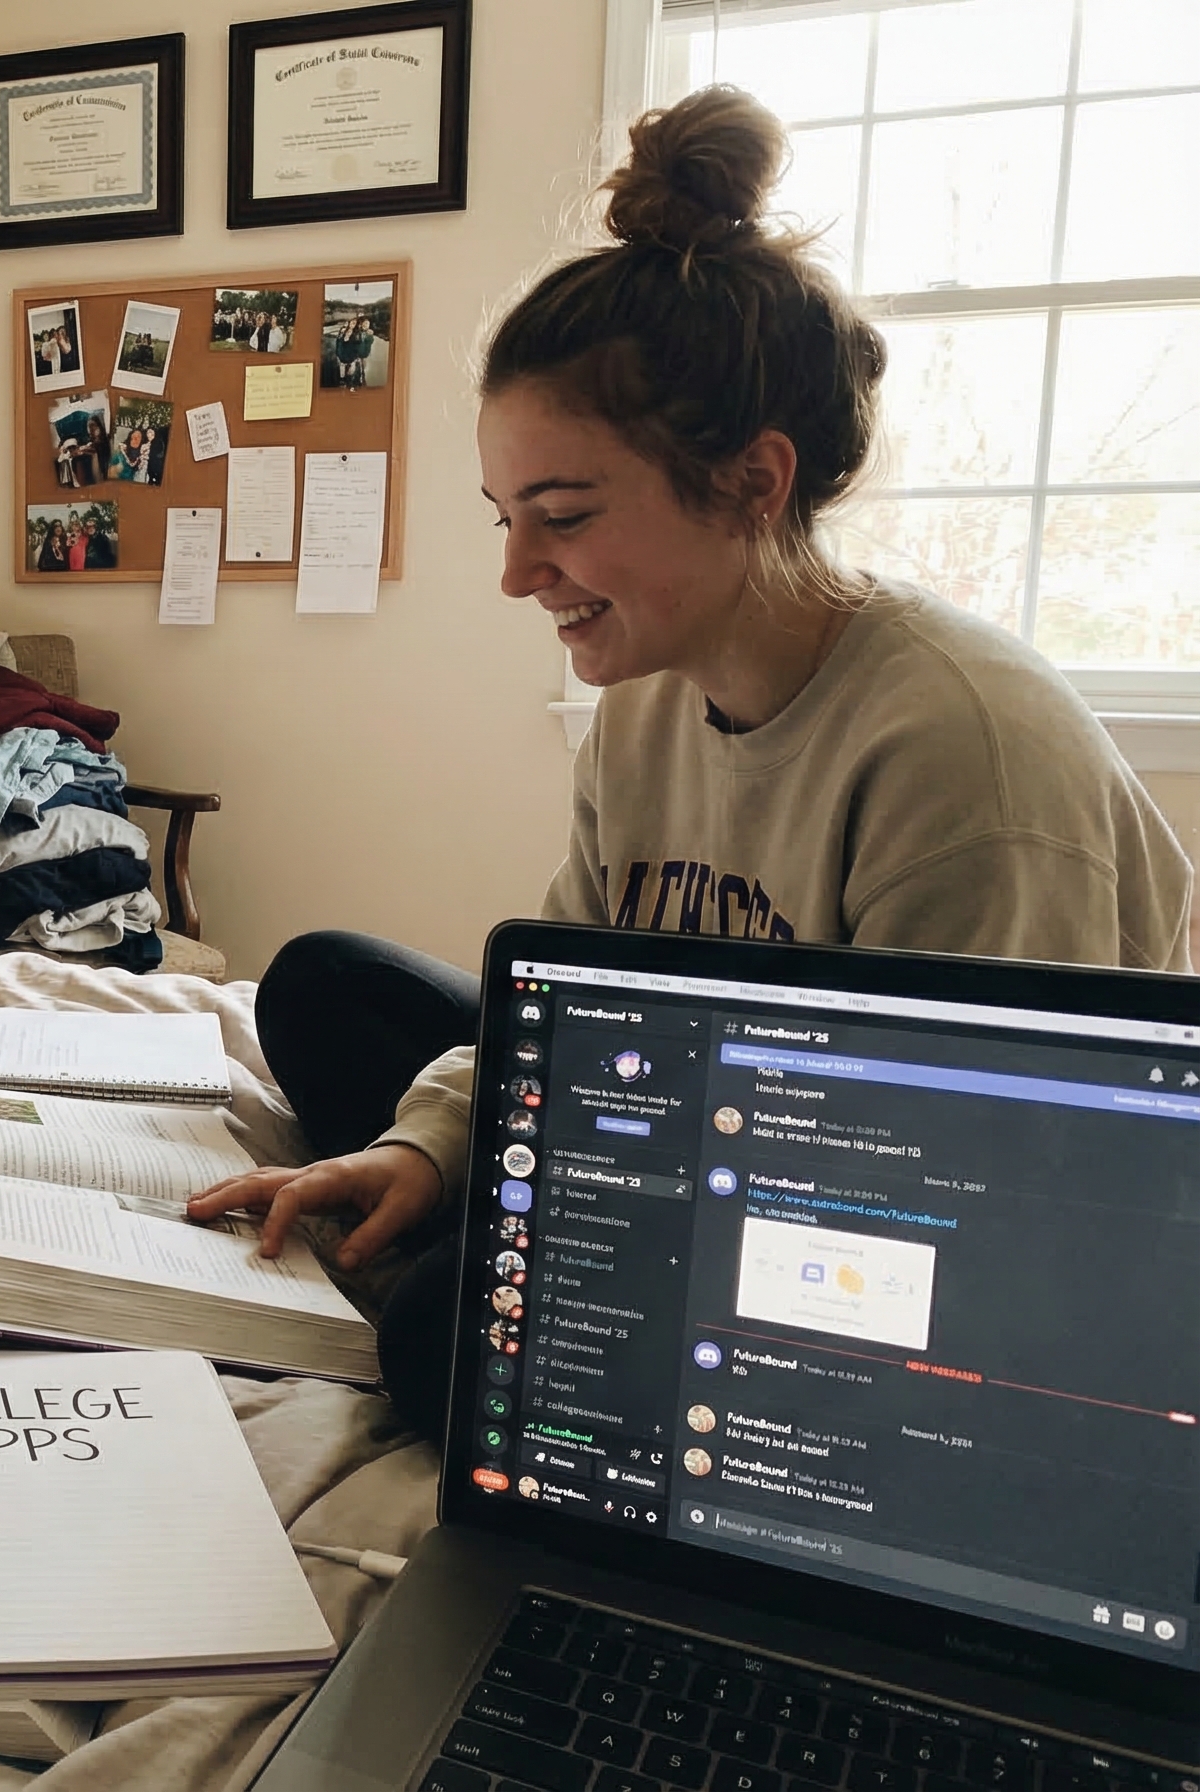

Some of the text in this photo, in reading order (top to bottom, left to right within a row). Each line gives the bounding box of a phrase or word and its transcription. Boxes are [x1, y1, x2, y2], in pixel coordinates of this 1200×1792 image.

[554, 1315, 612, 1336] FutureBound
[602, 1692, 615, 1704] Q
[665, 1709, 684, 1723] W
[600, 1735, 614, 1748] A
[735, 1730, 746, 1743] E
[669, 1754, 682, 1768] S
[803, 1751, 816, 1764] R
[737, 1776, 752, 1789] D
